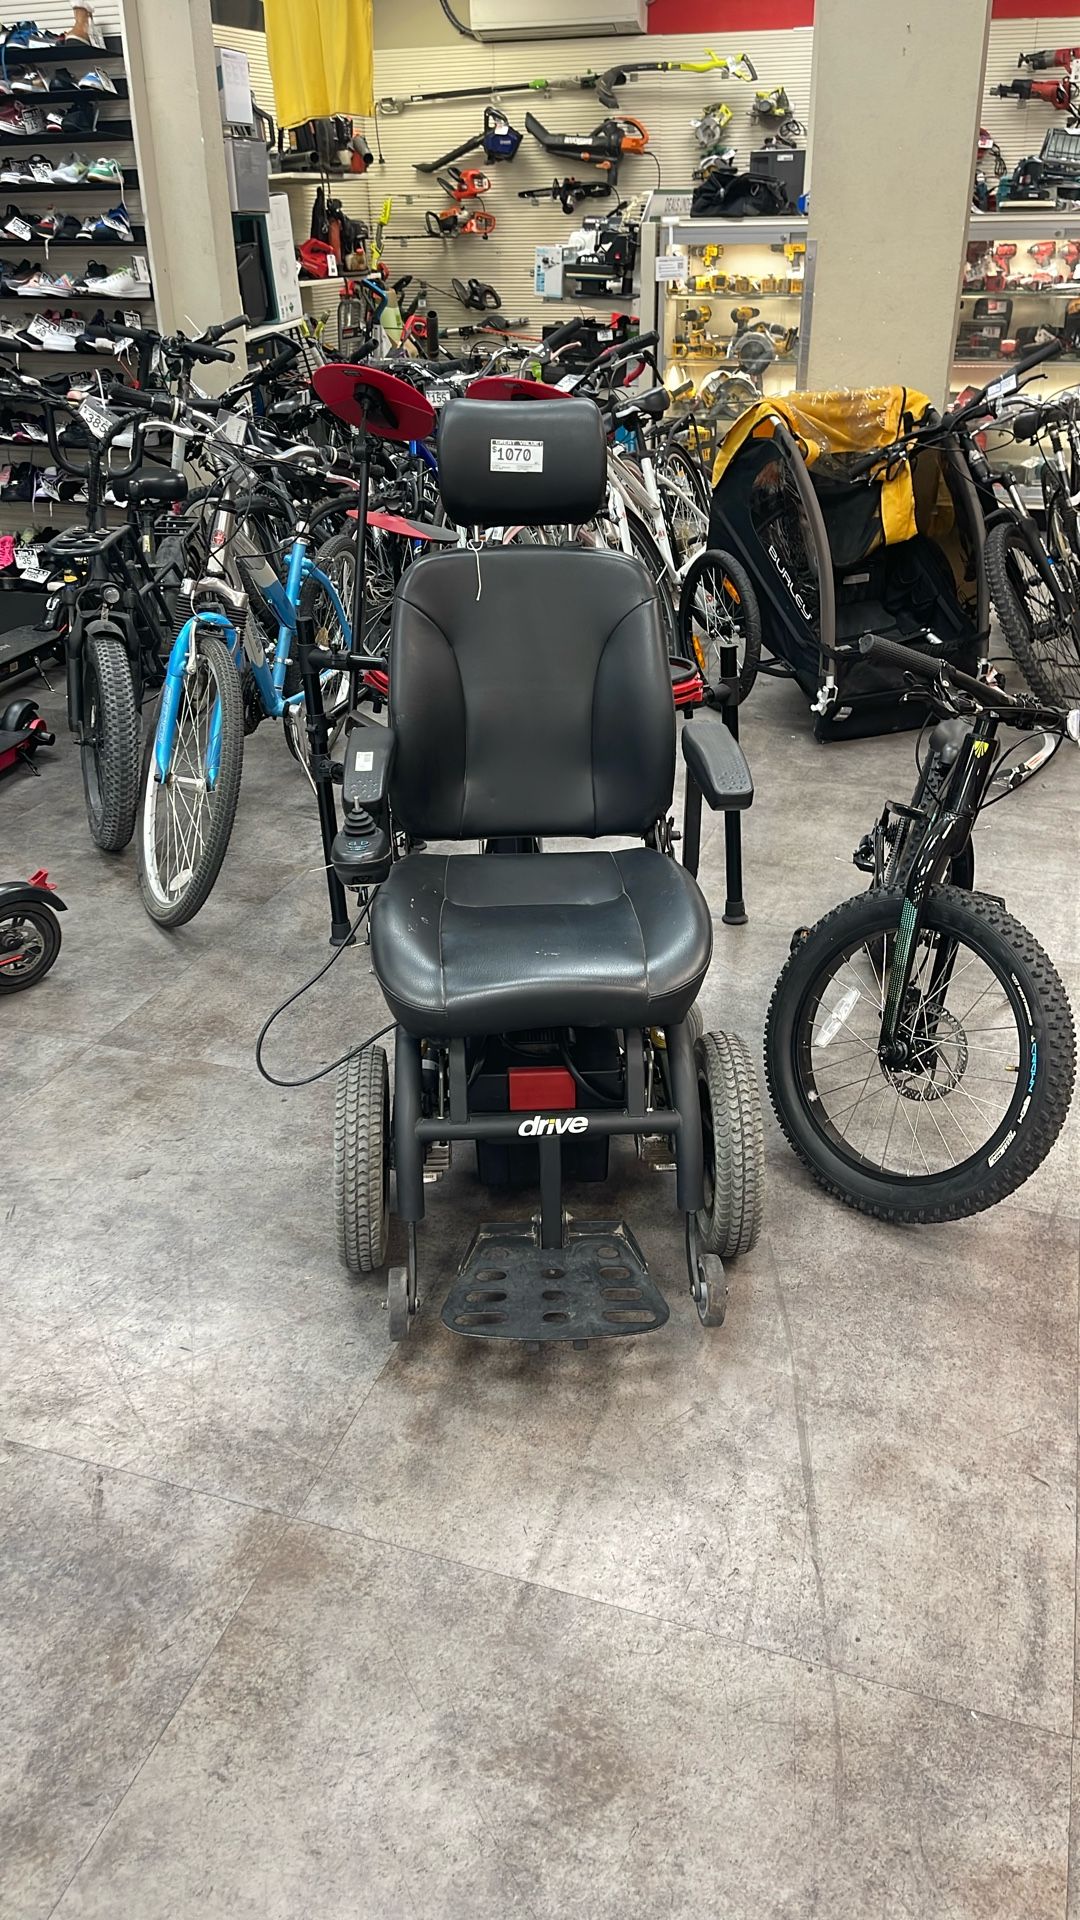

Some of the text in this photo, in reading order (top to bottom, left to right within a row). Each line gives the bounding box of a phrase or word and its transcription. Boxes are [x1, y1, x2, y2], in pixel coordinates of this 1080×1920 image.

[768, 545, 813, 620] BURLEY
[1028, 1042, 1038, 1093] CROWN
[518, 1115, 589, 1137] drive
